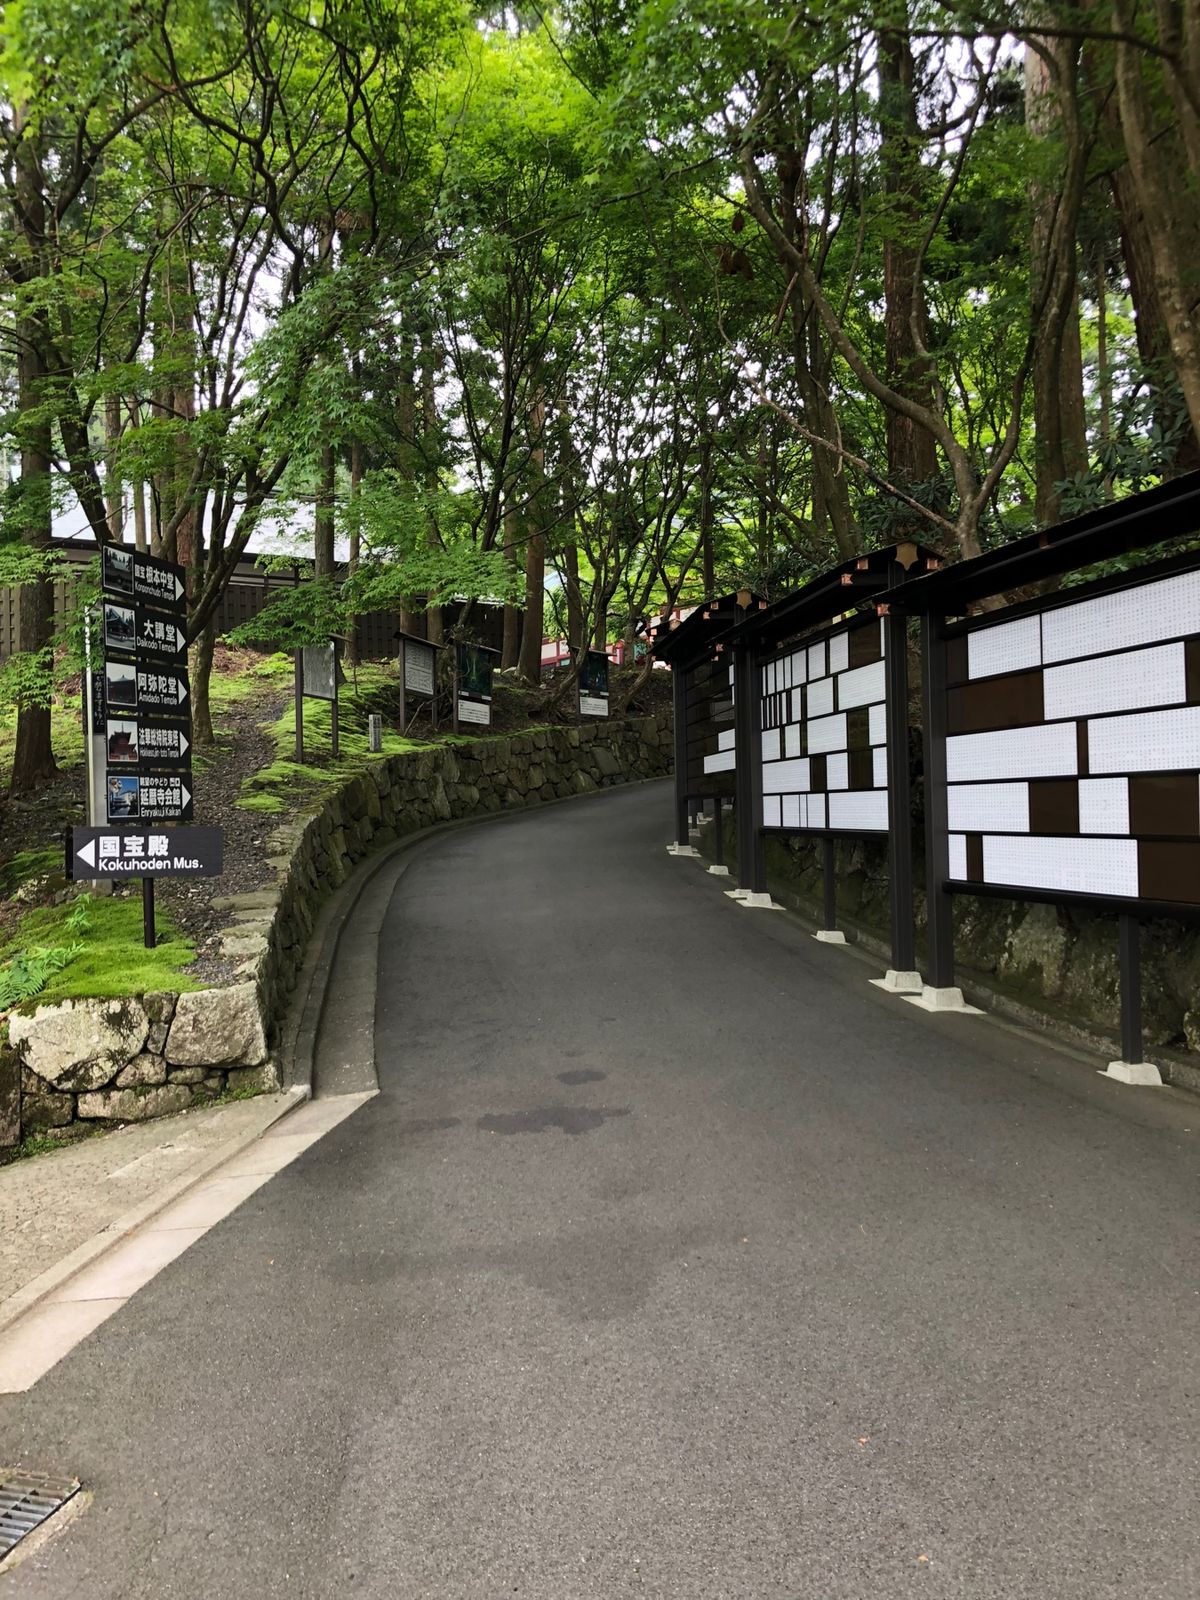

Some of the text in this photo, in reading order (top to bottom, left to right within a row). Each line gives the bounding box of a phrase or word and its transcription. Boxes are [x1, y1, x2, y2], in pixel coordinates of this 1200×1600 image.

[146, 565, 174, 590] 根本中堂
[161, 588, 174, 601] Temple
[143, 619, 176, 642] 大講堂
[136, 636, 176, 653] Daikodo Temple
[137, 672, 177, 693] 阿弥陀堂
[138, 691, 177, 705] Amidado Temple
[140, 787, 181, 806] 延暦寺会館
[140, 806, 182, 818] Enryakuji Kaikan
[98, 835, 169, 858] 国宝殿
[98, 856, 203, 871] Kokuhoden Mus.
